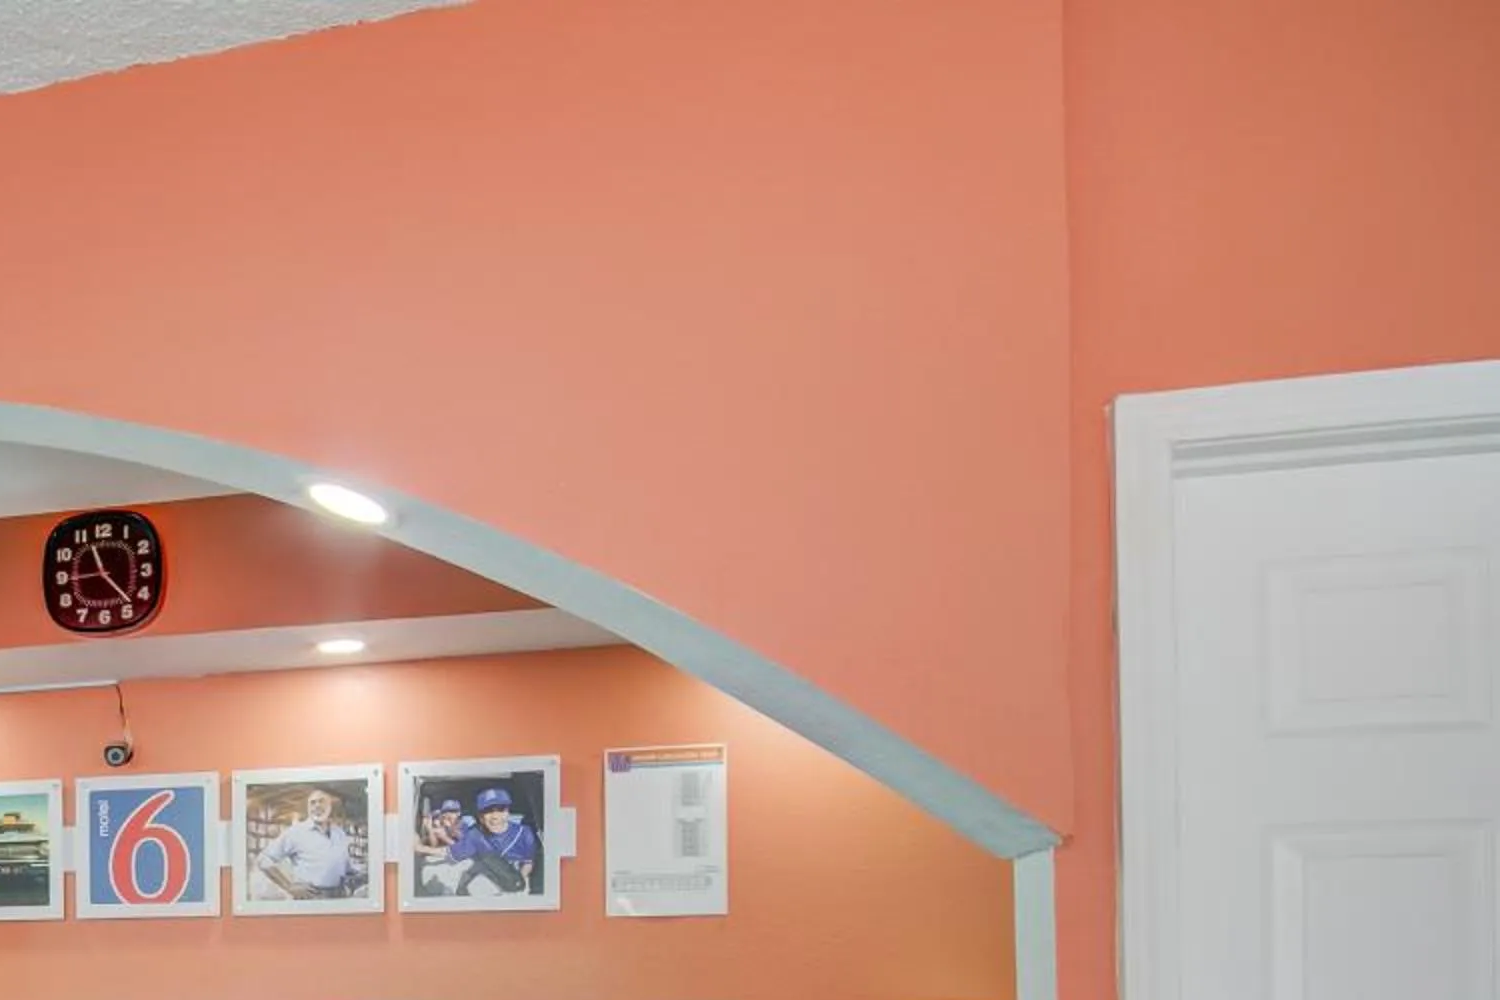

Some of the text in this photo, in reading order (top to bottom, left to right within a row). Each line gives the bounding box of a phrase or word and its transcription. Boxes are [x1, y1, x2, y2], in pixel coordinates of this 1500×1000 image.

[75, 529, 87, 543] 11
[95, 523, 112, 538] 12
[123, 524, 129, 539] 1
[137, 540, 149, 555] 2
[56, 548, 72, 562] 10
[140, 563, 152, 577] 3
[56, 571, 69, 584] 9
[60, 593, 72, 607] 8
[137, 586, 150, 600] 4
[76, 608, 88, 623] 7
[99, 610, 111, 624] 6
[121, 605, 133, 619] 5
[98, 789, 191, 905] motel 6
